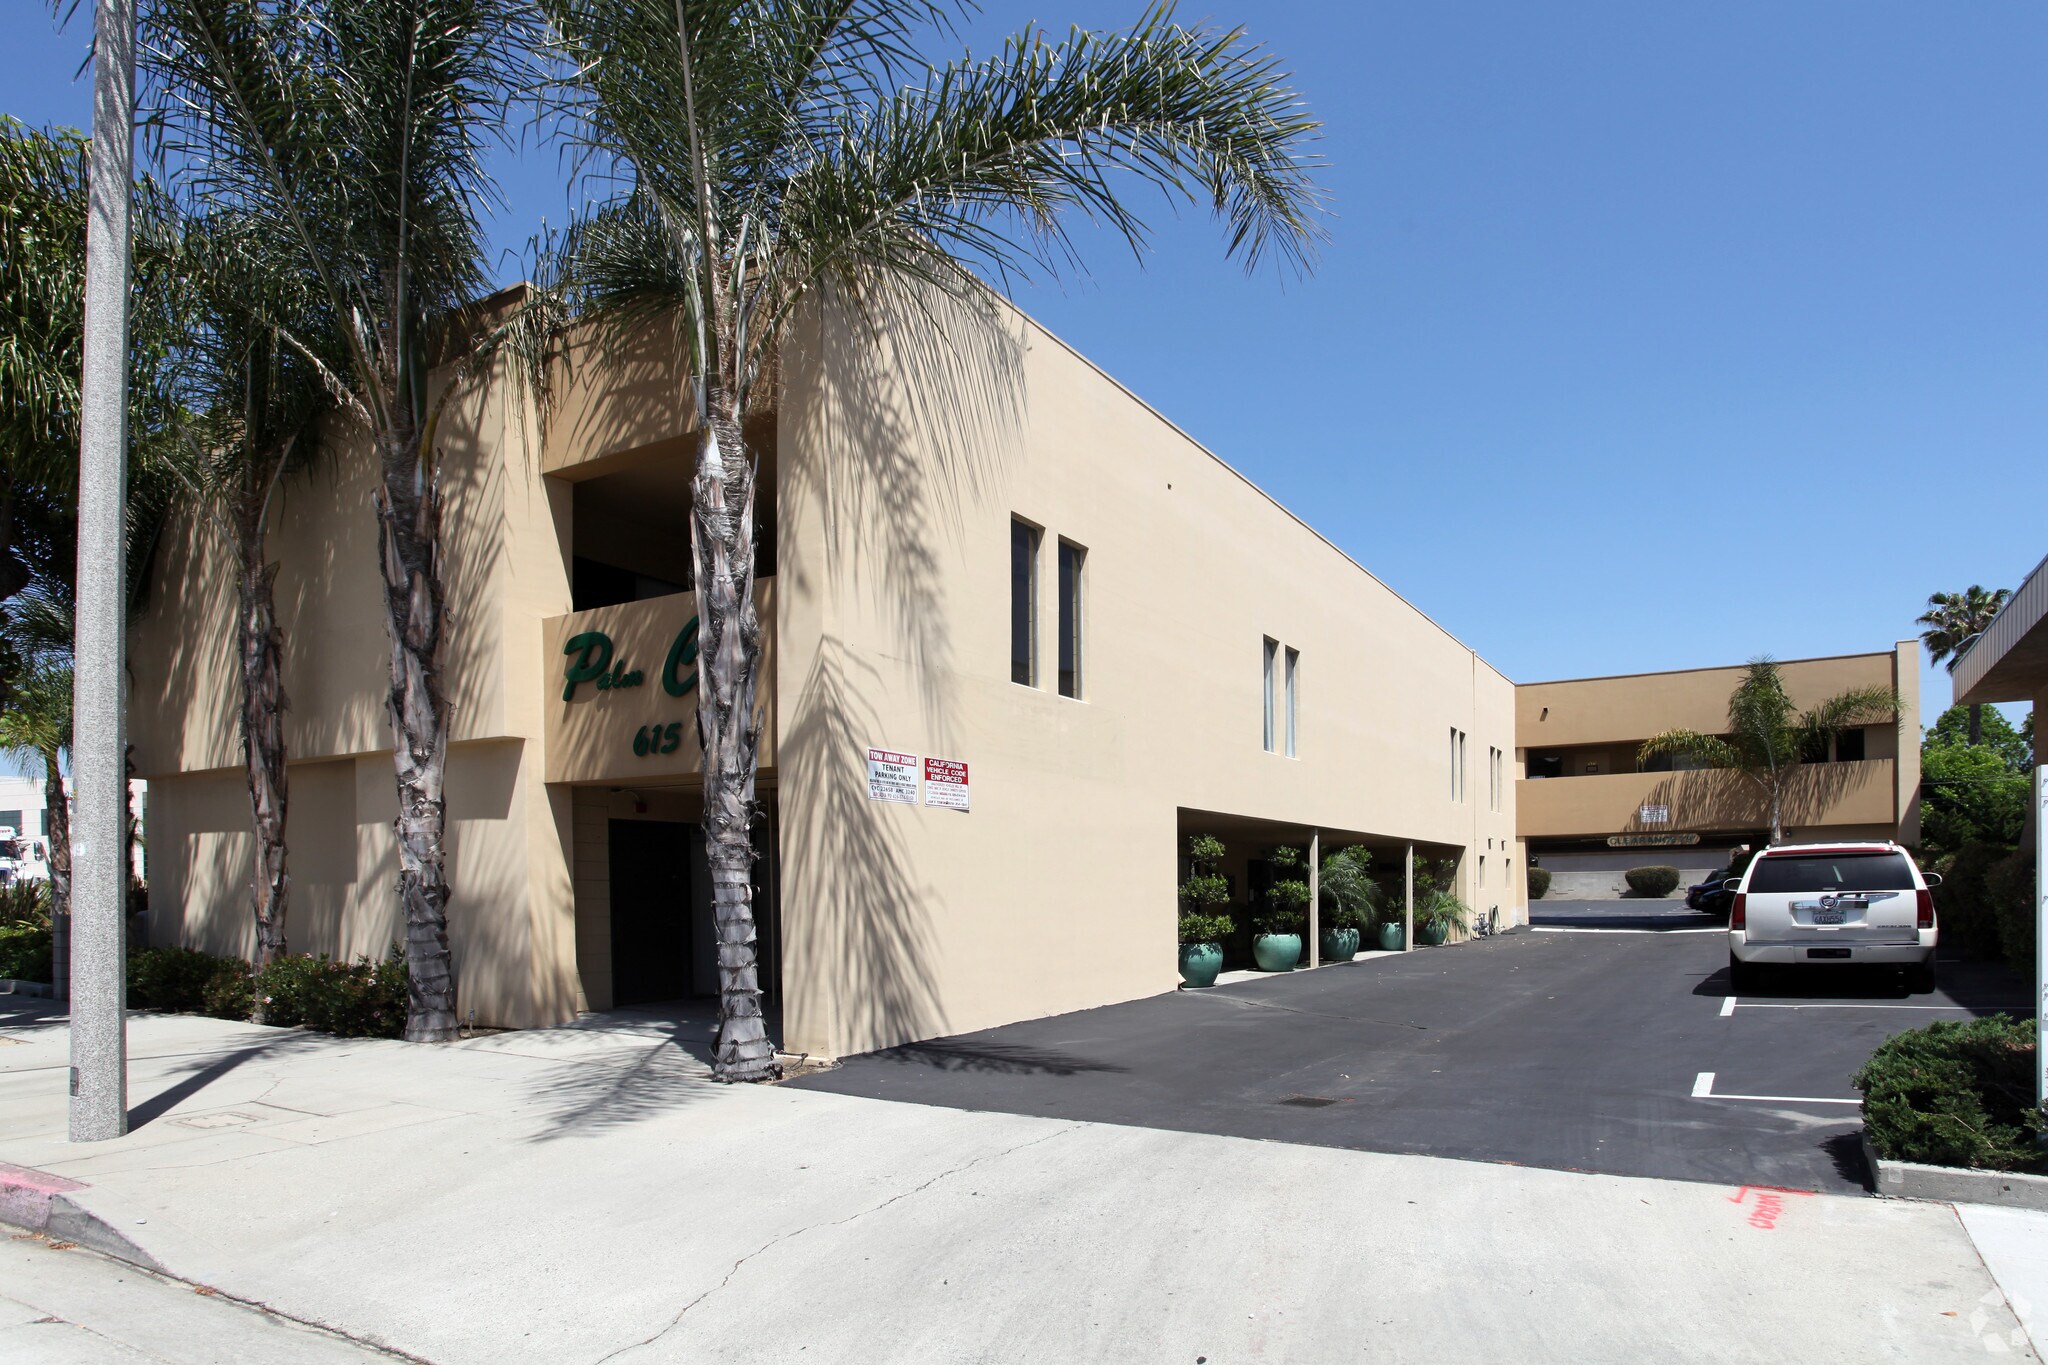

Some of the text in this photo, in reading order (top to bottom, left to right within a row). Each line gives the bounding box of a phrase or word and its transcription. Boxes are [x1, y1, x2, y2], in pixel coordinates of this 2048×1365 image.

[563, 631, 643, 702] Palm
[632, 722, 682, 757] 615
[871, 751, 916, 765] TOW AWAY ZONE
[882, 764, 904, 773] TENANT
[929, 760, 963, 770] CALIFORNIA
[875, 771, 897, 780] PARKING
[927, 767, 949, 775] VEHICLE
[931, 774, 963, 783] ENFORCED
[1609, 836, 1675, 845] CLEARANCE
